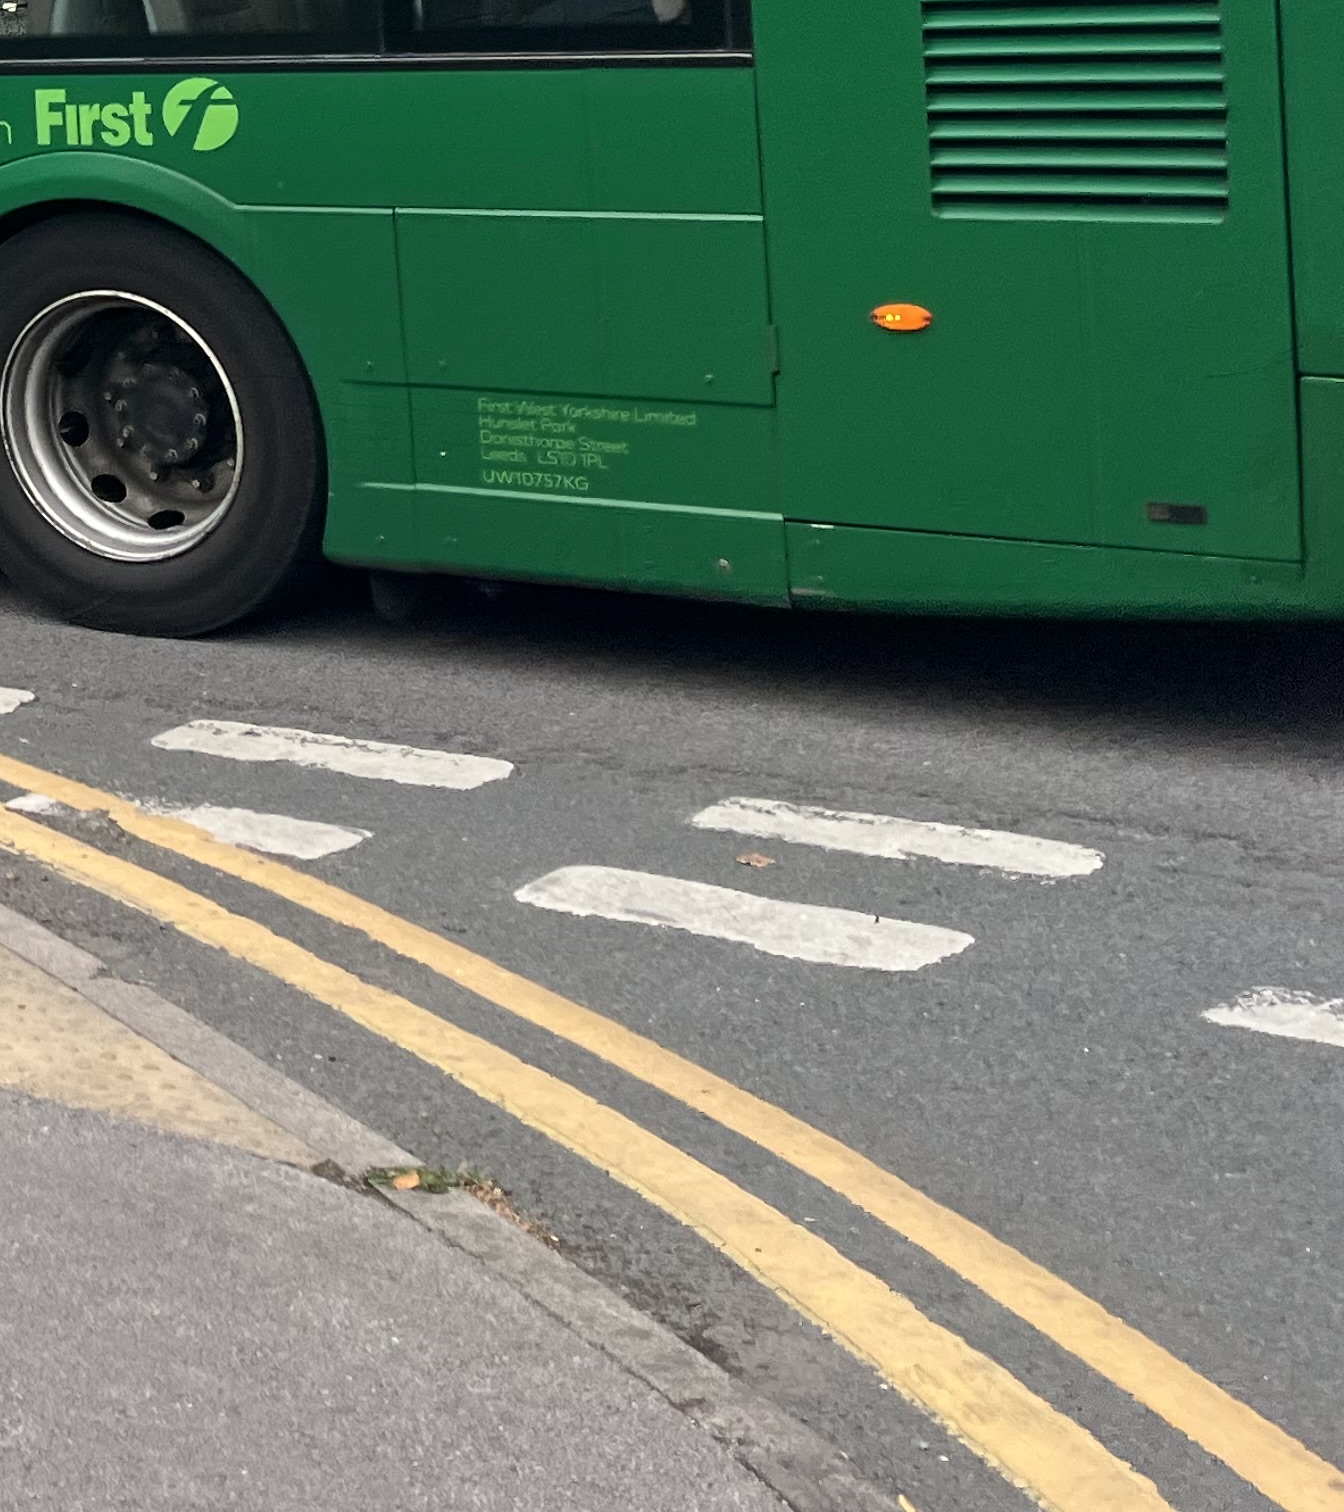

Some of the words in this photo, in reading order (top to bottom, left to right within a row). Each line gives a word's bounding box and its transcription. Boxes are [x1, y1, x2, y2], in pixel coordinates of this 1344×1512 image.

[34, 88, 154, 147] First
[478, 397, 512, 416] First
[517, 400, 557, 418] West
[562, 403, 631, 423] Yorkshire
[633, 406, 698, 427] Limited
[478, 415, 535, 431] Hunslet
[541, 417, 576, 434] Park
[577, 435, 629, 455] Street
[480, 446, 528, 464] Leeds
[537, 450, 578, 468] LS10
